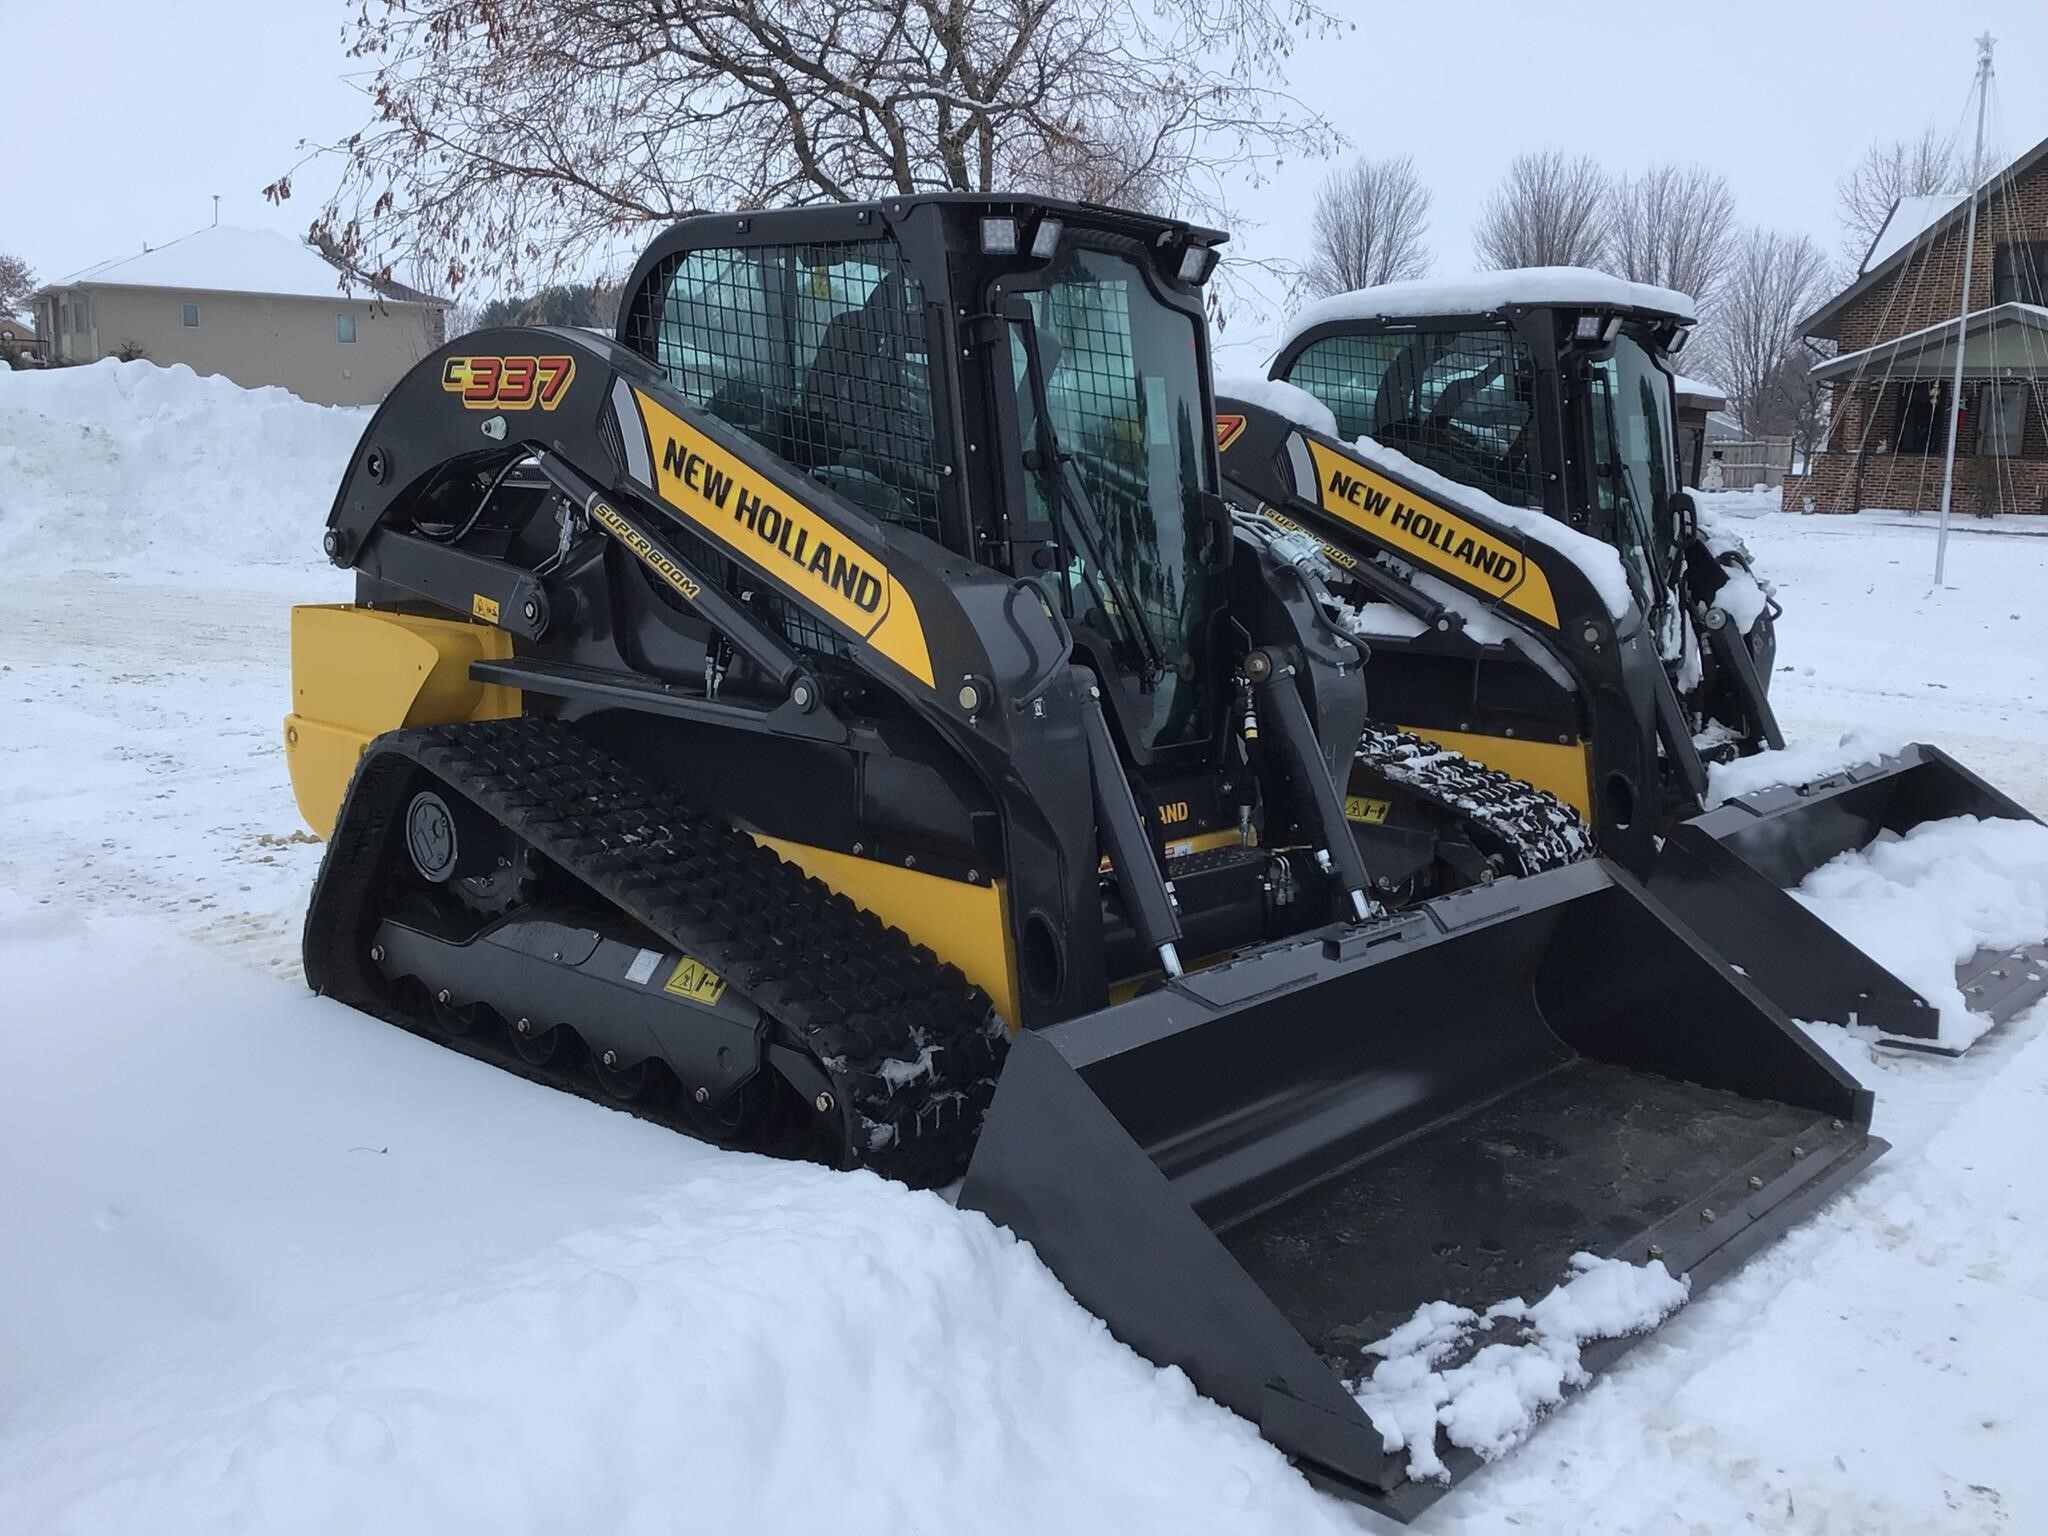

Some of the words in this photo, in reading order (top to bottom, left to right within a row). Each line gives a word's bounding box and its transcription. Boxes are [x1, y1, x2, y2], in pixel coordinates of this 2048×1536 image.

[442, 355, 577, 411] C337
[662, 437, 734, 509] NEW
[734, 486, 883, 614] HOLLAND
[1328, 470, 1391, 518] NEW
[1390, 502, 1517, 584] HOLLAND
